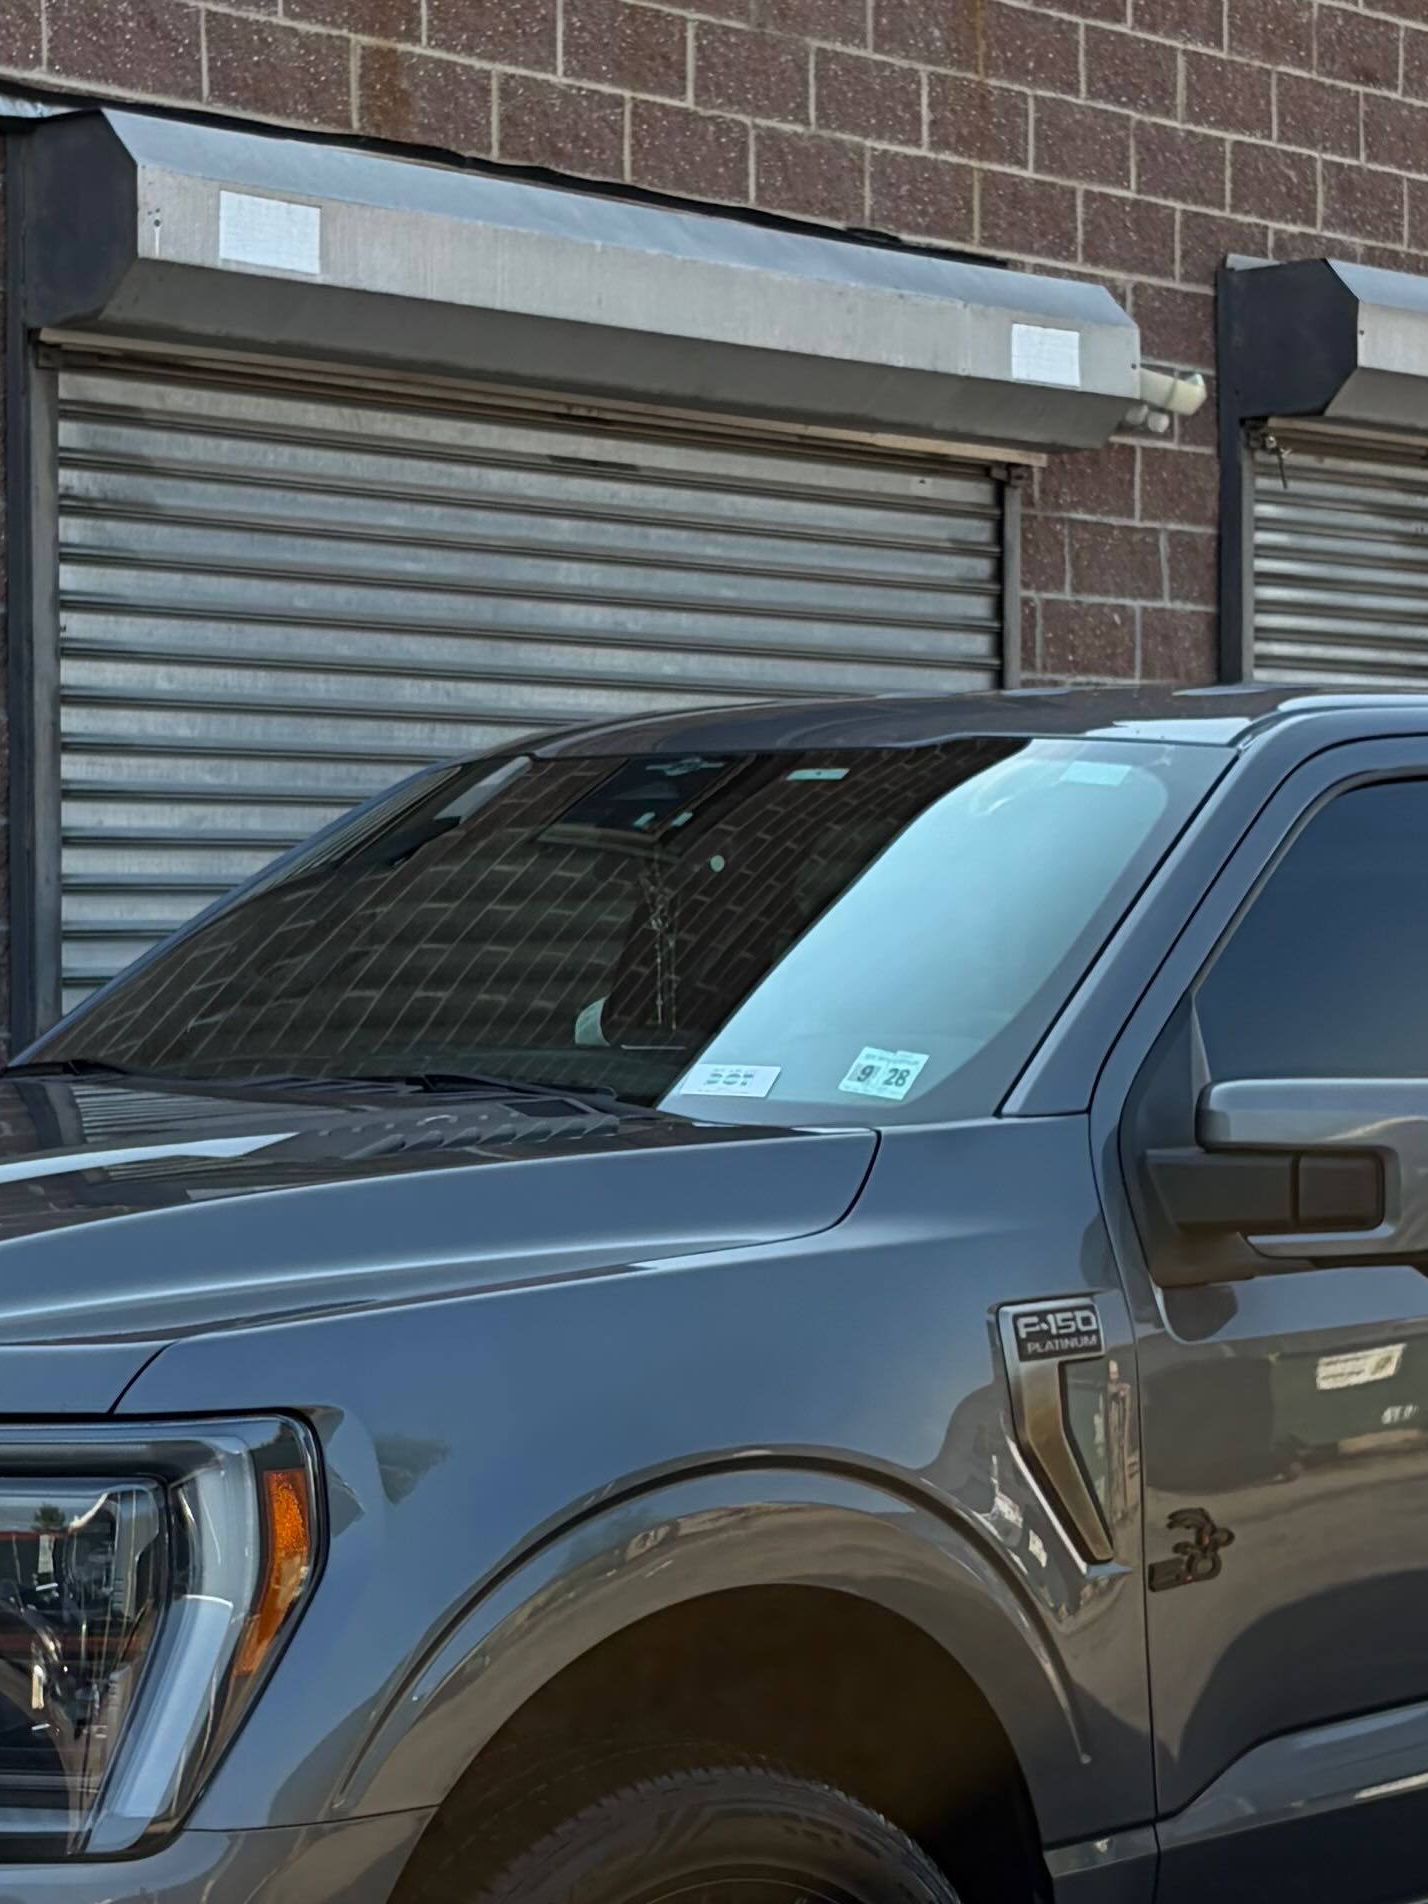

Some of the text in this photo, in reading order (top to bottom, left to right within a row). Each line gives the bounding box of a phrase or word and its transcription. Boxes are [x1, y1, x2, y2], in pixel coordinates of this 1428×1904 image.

[857, 1065, 911, 1087] 9 28
[1017, 1309, 1097, 1338] F-150
[1027, 1334, 1097, 1354] PLATINUM
